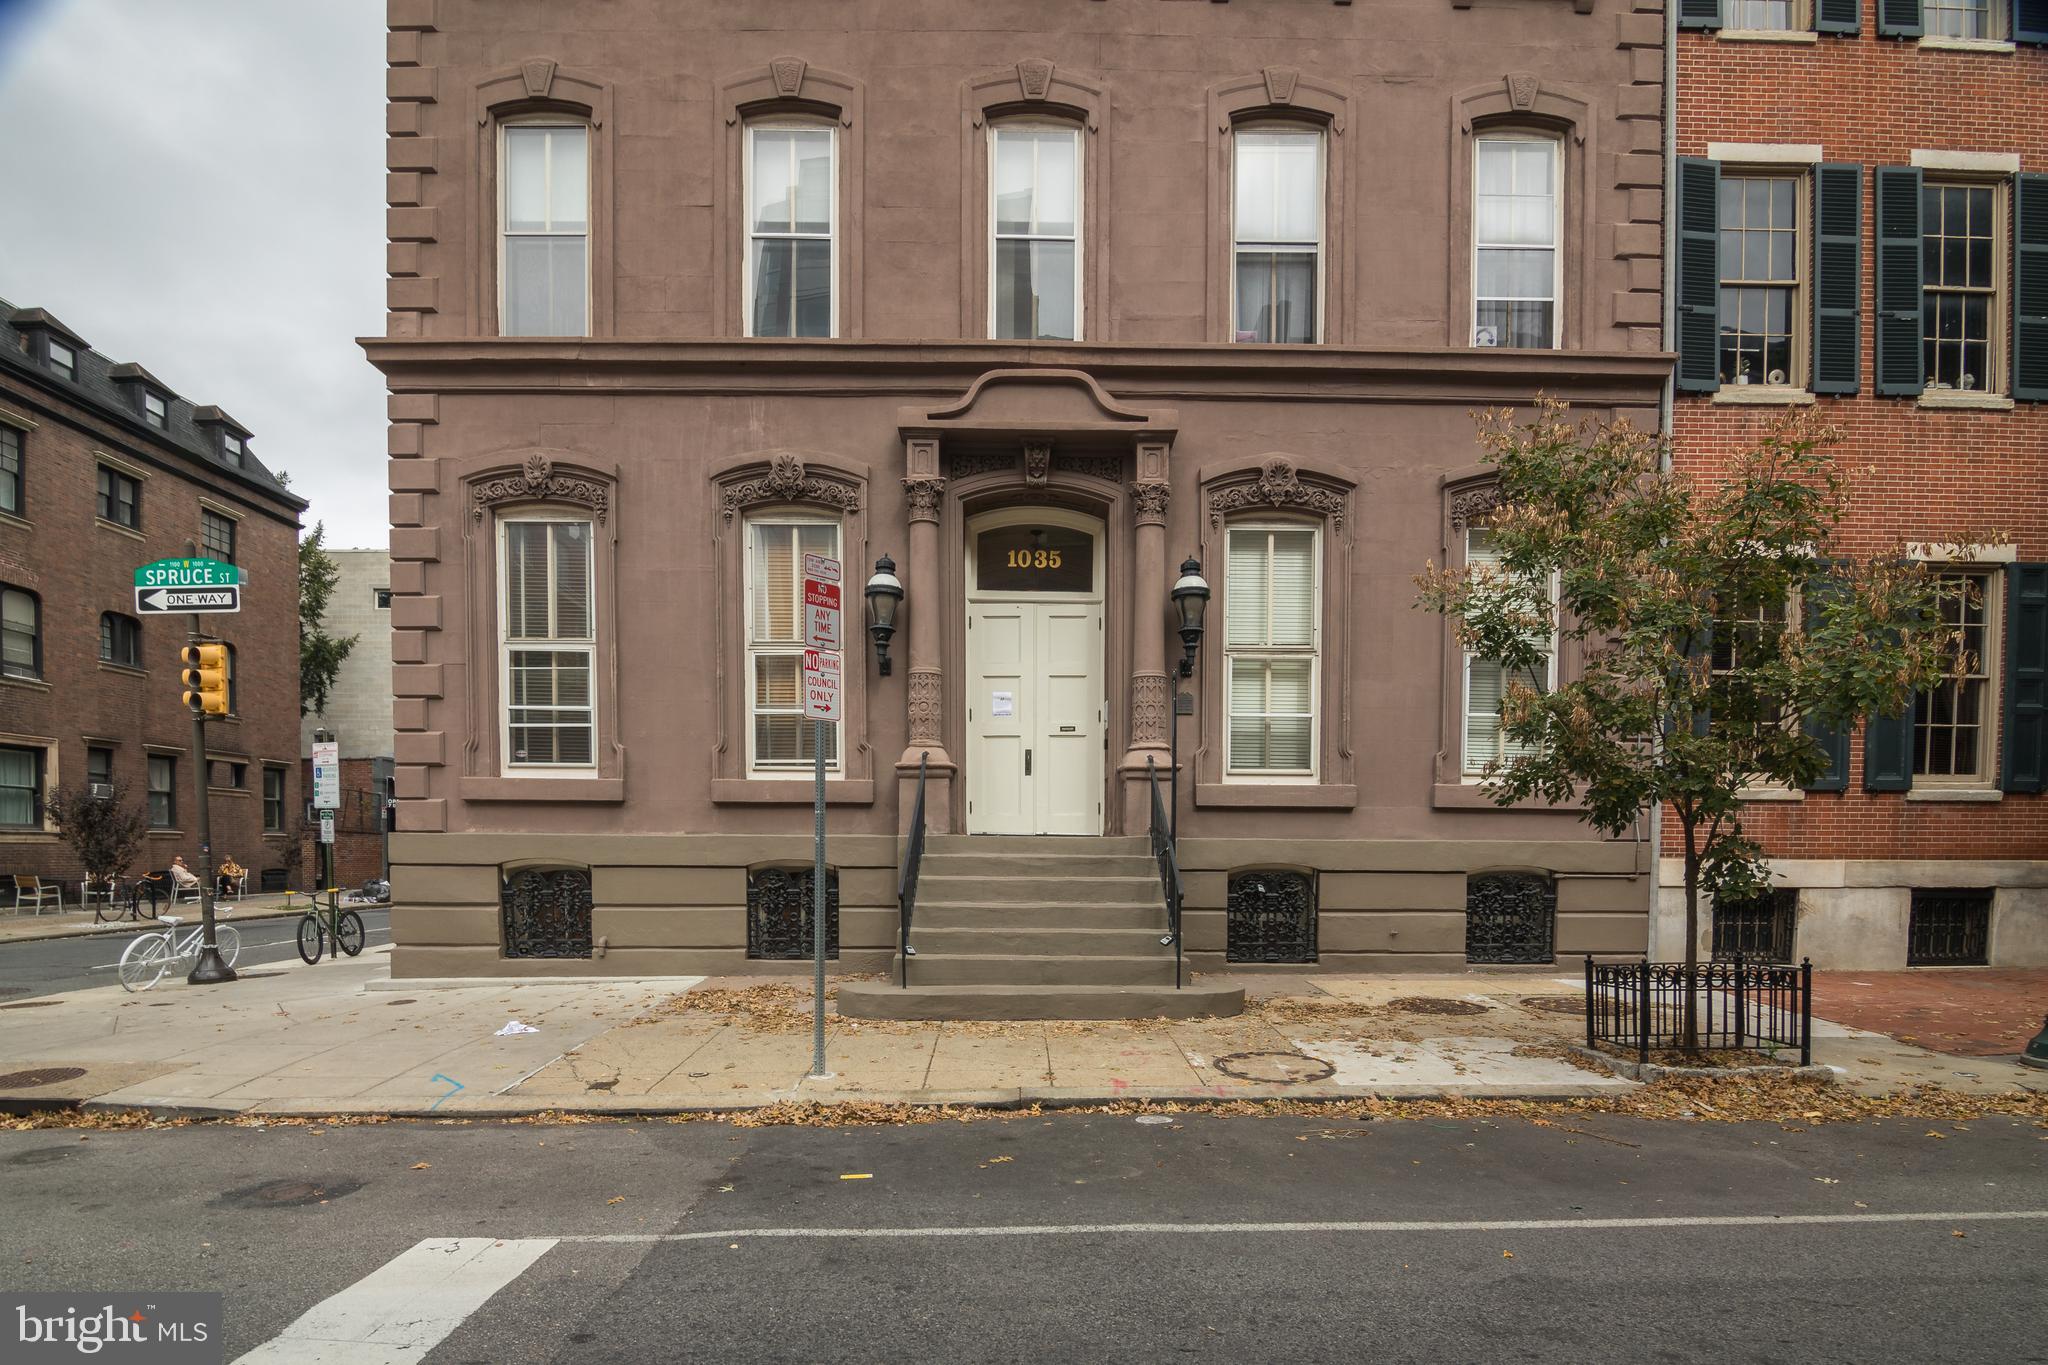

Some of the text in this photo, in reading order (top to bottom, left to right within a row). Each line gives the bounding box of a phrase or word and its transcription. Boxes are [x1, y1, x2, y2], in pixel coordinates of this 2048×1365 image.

[1007, 549, 1062, 569] 1035
[145, 569, 230, 585] SPRUCE ST
[817, 584, 828, 594] NO
[167, 594, 226, 605] ONE WAY
[807, 592, 838, 608] STOPPING
[814, 608, 831, 621] ANY
[814, 621, 832, 635] TIME
[805, 652, 839, 670] NO PARKING
[807, 676, 838, 690] COUNCIL
[810, 689, 834, 702] ONLY
